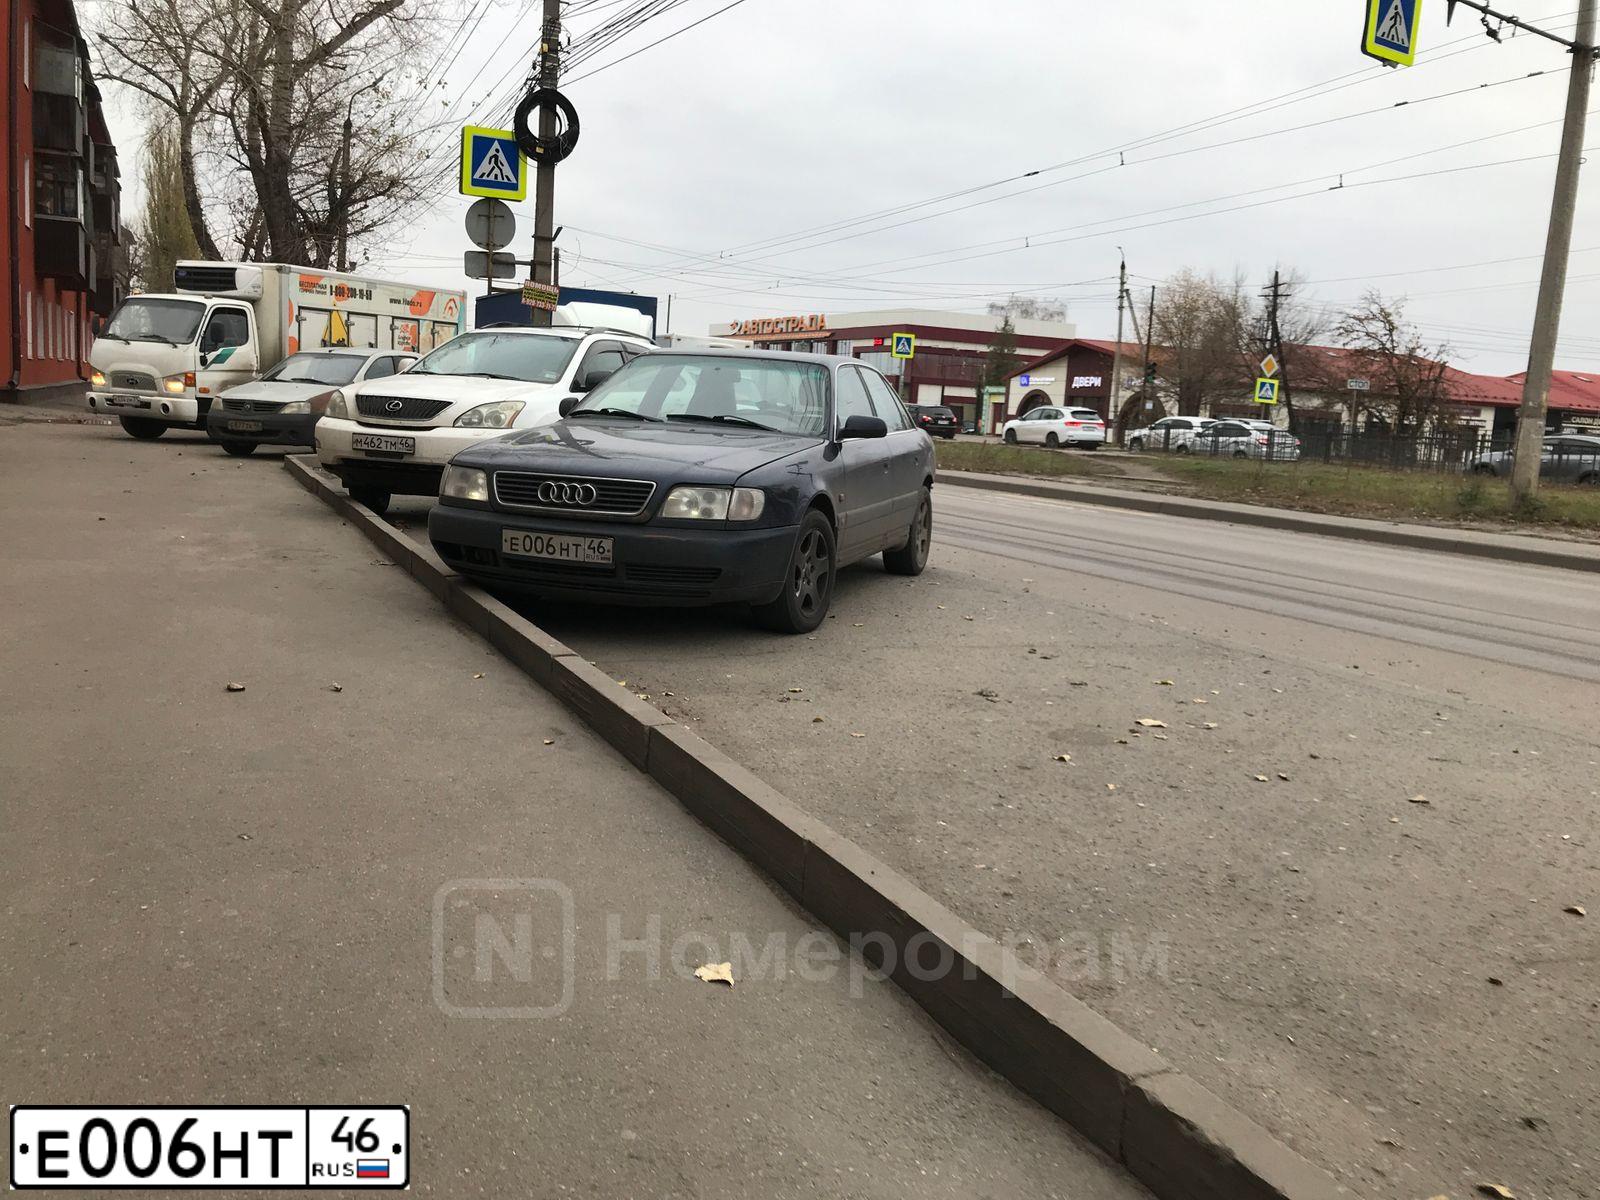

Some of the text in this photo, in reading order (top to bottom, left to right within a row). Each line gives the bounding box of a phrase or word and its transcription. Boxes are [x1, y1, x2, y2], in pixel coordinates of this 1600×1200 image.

[741, 314, 826, 335] АВТОСТРАДА
[1072, 376, 1101, 388] ДВЕРИ
[399, 438, 410, 448] 46
[510, 534, 606, 558] Е006НТ 46
